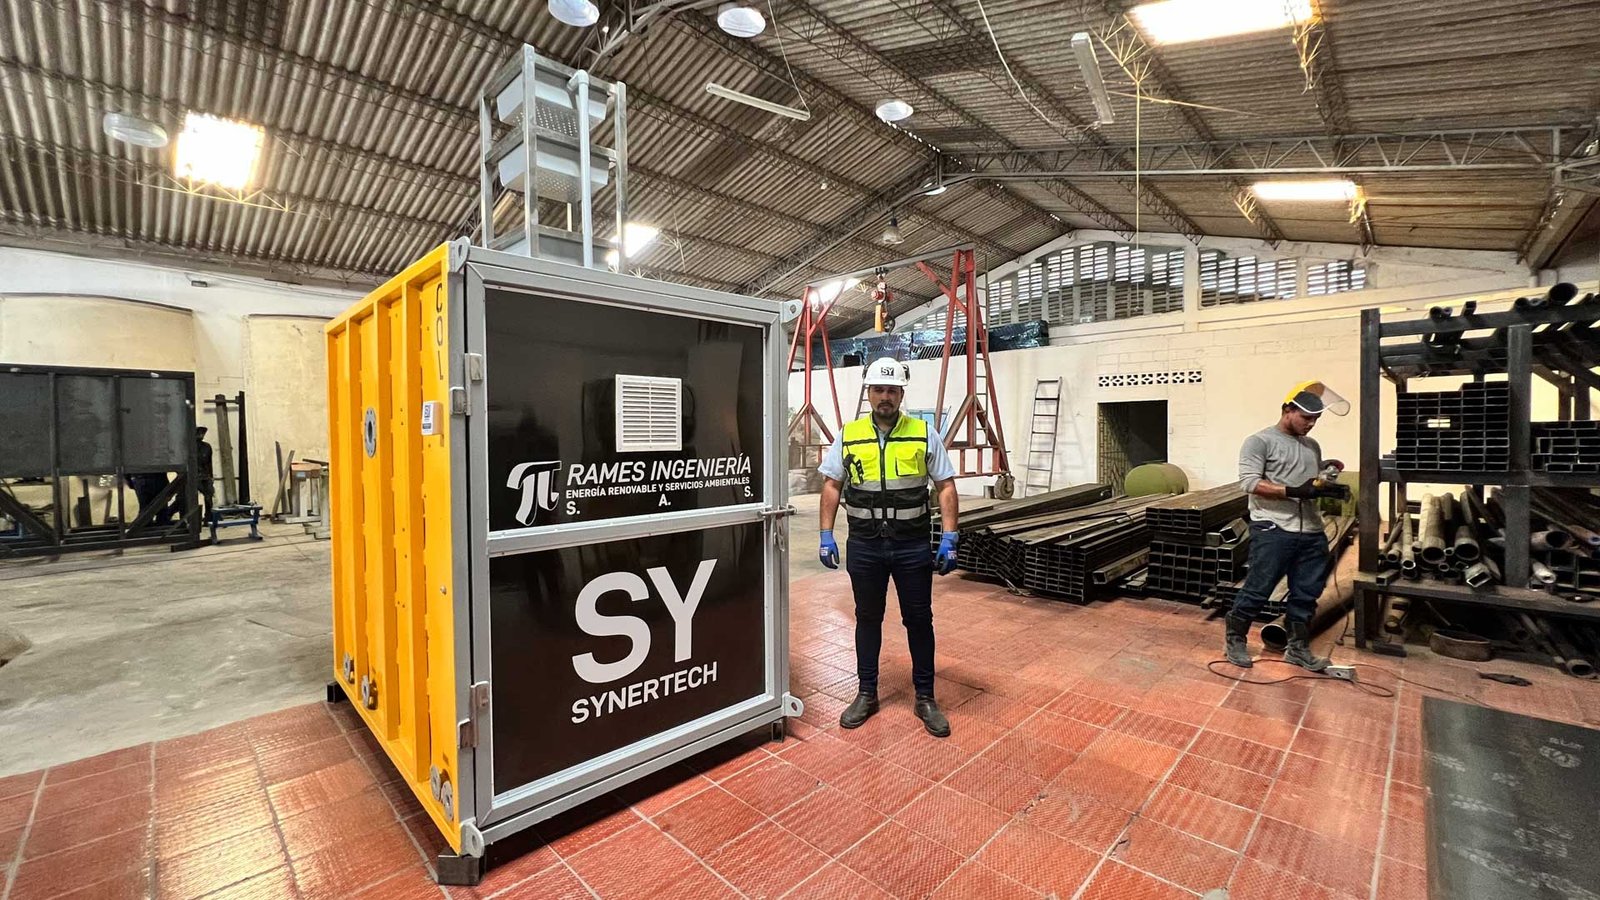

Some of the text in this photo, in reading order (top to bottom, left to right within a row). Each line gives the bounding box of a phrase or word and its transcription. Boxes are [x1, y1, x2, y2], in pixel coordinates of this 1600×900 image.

[881, 367, 894, 375] SY
[566, 453, 752, 486] RAMES INGENIERÍA
[566, 476, 750, 499] ENERGÍA RENOVABLE Y SERVICIOS AMBIENTALES
[566, 486, 754, 515] S. A. S.
[571, 558, 718, 684] SY
[571, 661, 718, 724] SYNERTECH
